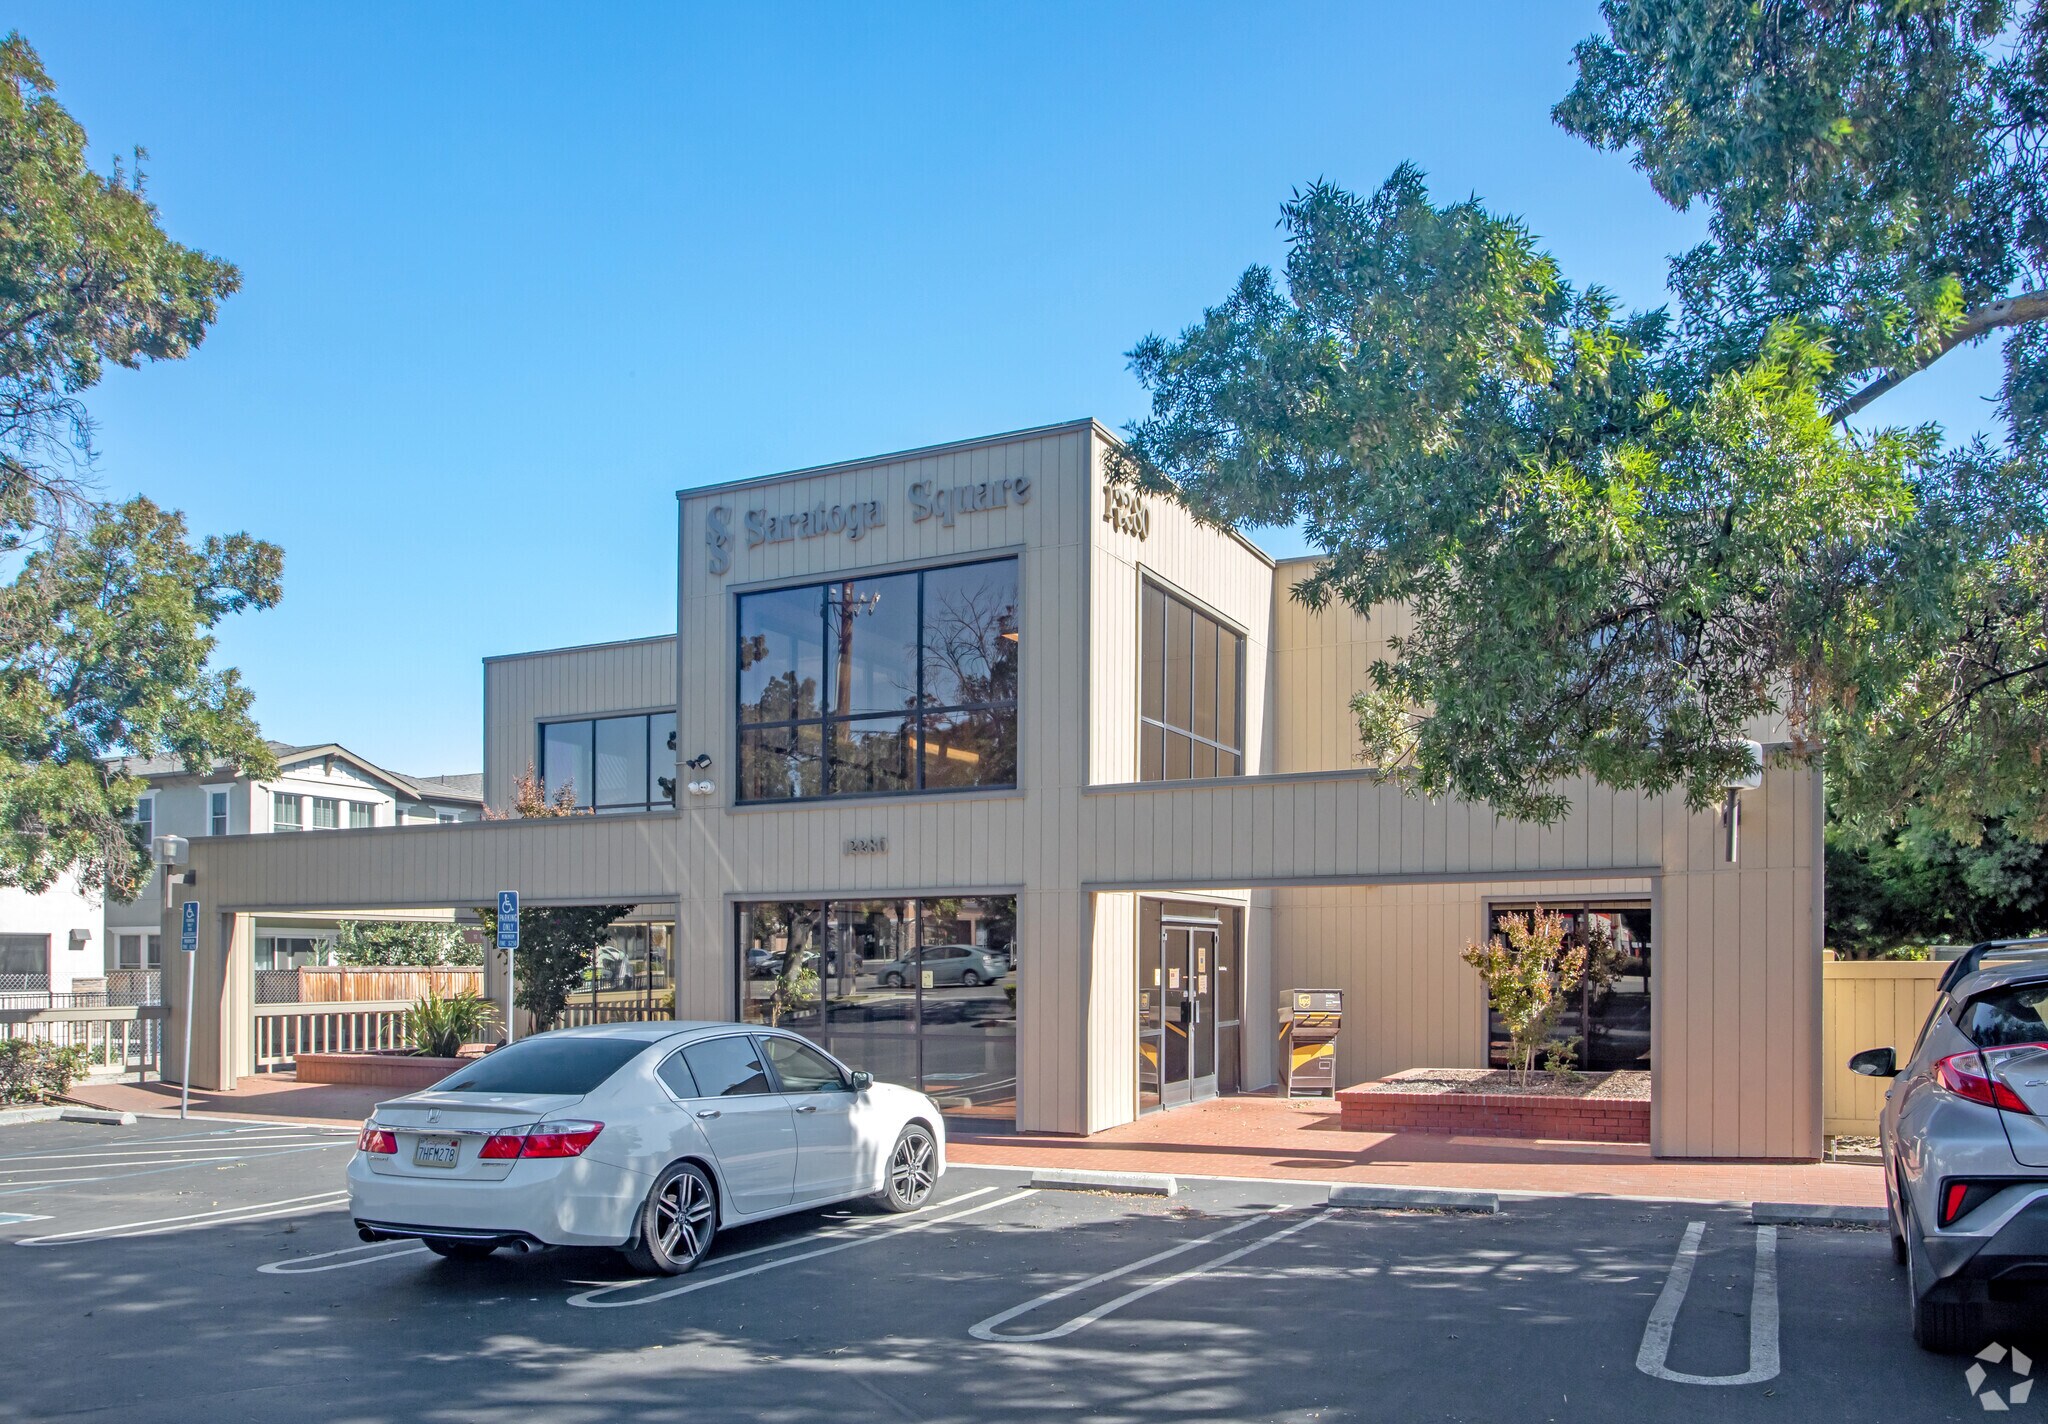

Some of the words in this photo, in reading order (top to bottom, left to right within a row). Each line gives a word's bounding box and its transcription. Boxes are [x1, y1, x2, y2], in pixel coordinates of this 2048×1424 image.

[744, 500, 885, 549] Saratoga
[908, 476, 1031, 528] Square
[503, 923, 514, 931] ONLY
[419, 1147, 455, 1161] 7HFM278
